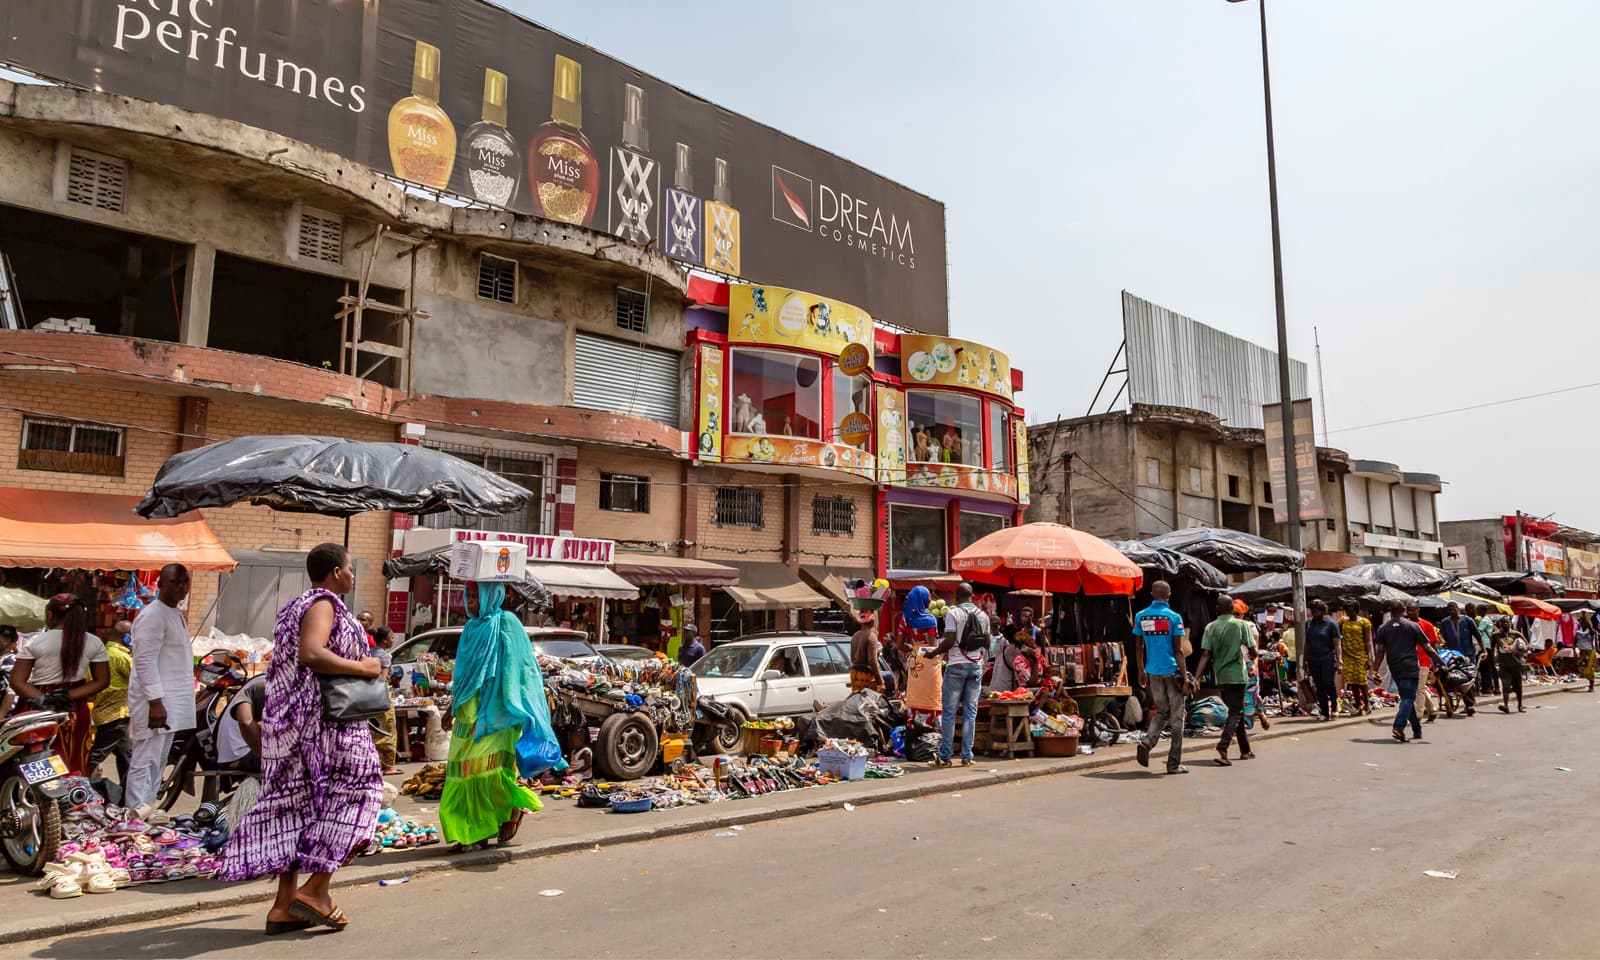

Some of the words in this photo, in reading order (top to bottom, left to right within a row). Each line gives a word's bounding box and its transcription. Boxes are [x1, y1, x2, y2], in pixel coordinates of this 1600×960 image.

[113, 4, 366, 112] perfumes
[408, 126, 438, 145] Miss
[478, 149, 506, 168] Miss
[547, 156, 581, 179] Miss
[622, 195, 649, 216] VIP
[819, 184, 914, 254] DREAM
[674, 223, 693, 239] VIP
[714, 238, 732, 252] VIP
[819, 224, 915, 269] COSMETICS
[563, 539, 612, 562] SUPPLY
[1015, 558, 1040, 567] Kash
[1046, 558, 1072, 567] Kash
